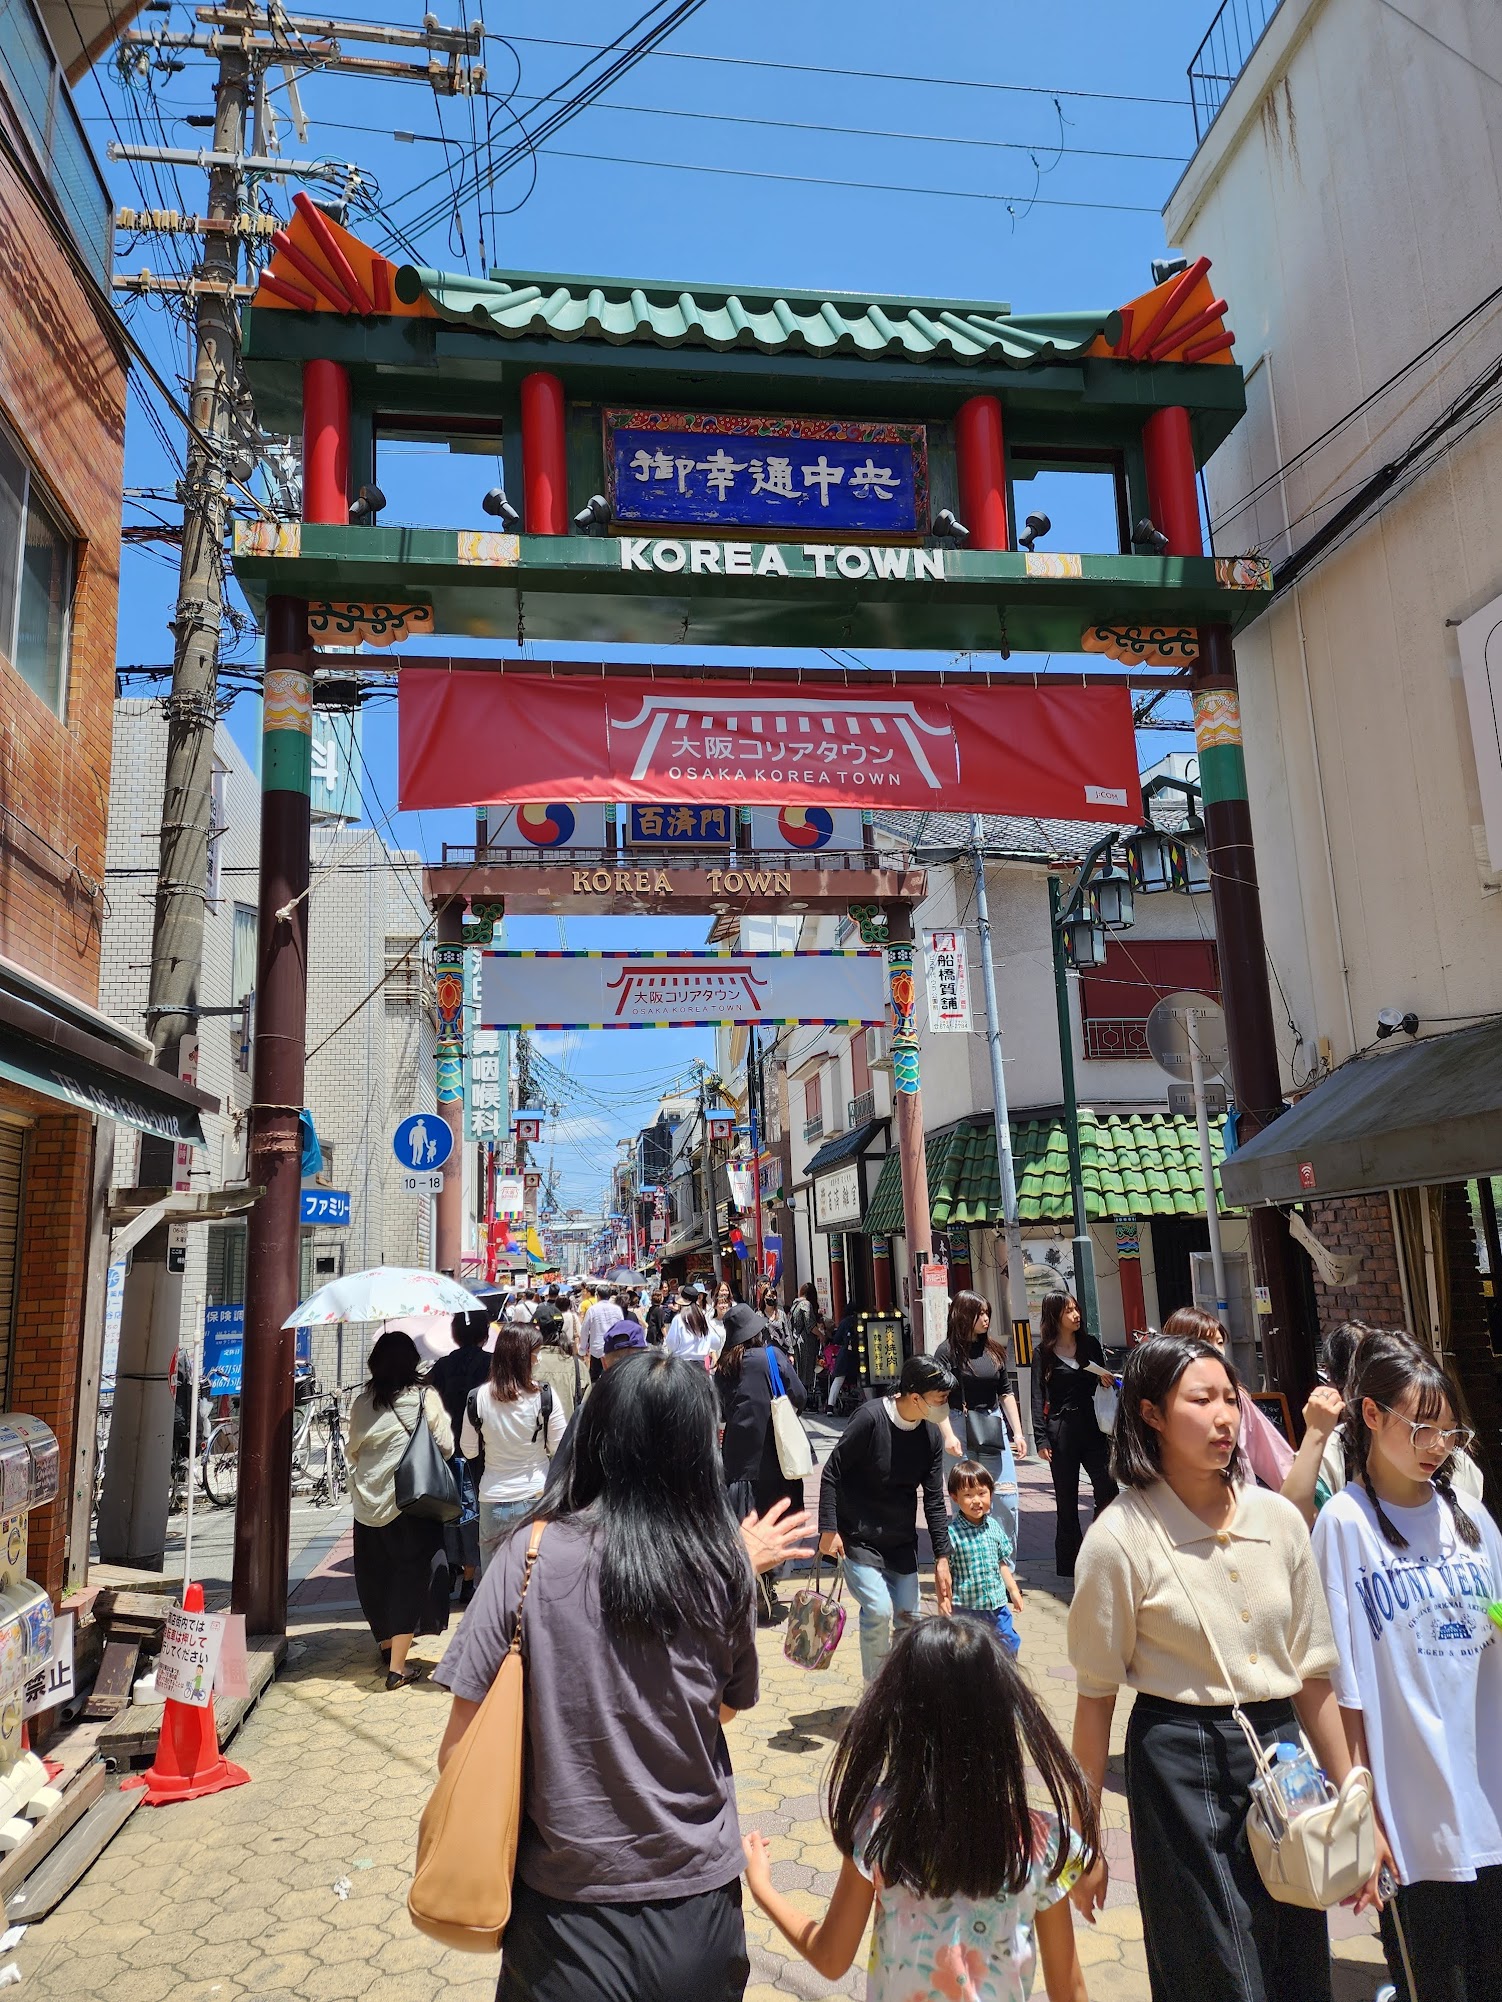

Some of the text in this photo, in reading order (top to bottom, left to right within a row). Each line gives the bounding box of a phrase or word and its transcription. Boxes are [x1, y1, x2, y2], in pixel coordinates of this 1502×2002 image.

[630, 448, 900, 507] 御幸通中央
[621, 537, 947, 582] KOREA TOWN
[671, 736, 894, 766] 大阪コリアタウン
[668, 766, 901, 786] OSAKA KOREA TOWN
[638, 807, 727, 837] 百済門
[572, 871, 793, 894] KOREA TOWN
[632, 1007, 668, 1015] OSAKA
[711, 1004, 743, 1012] TOWN
[634, 989, 741, 1004] 大阪コリアタウン
[49, 1068, 94, 1108] TEL
